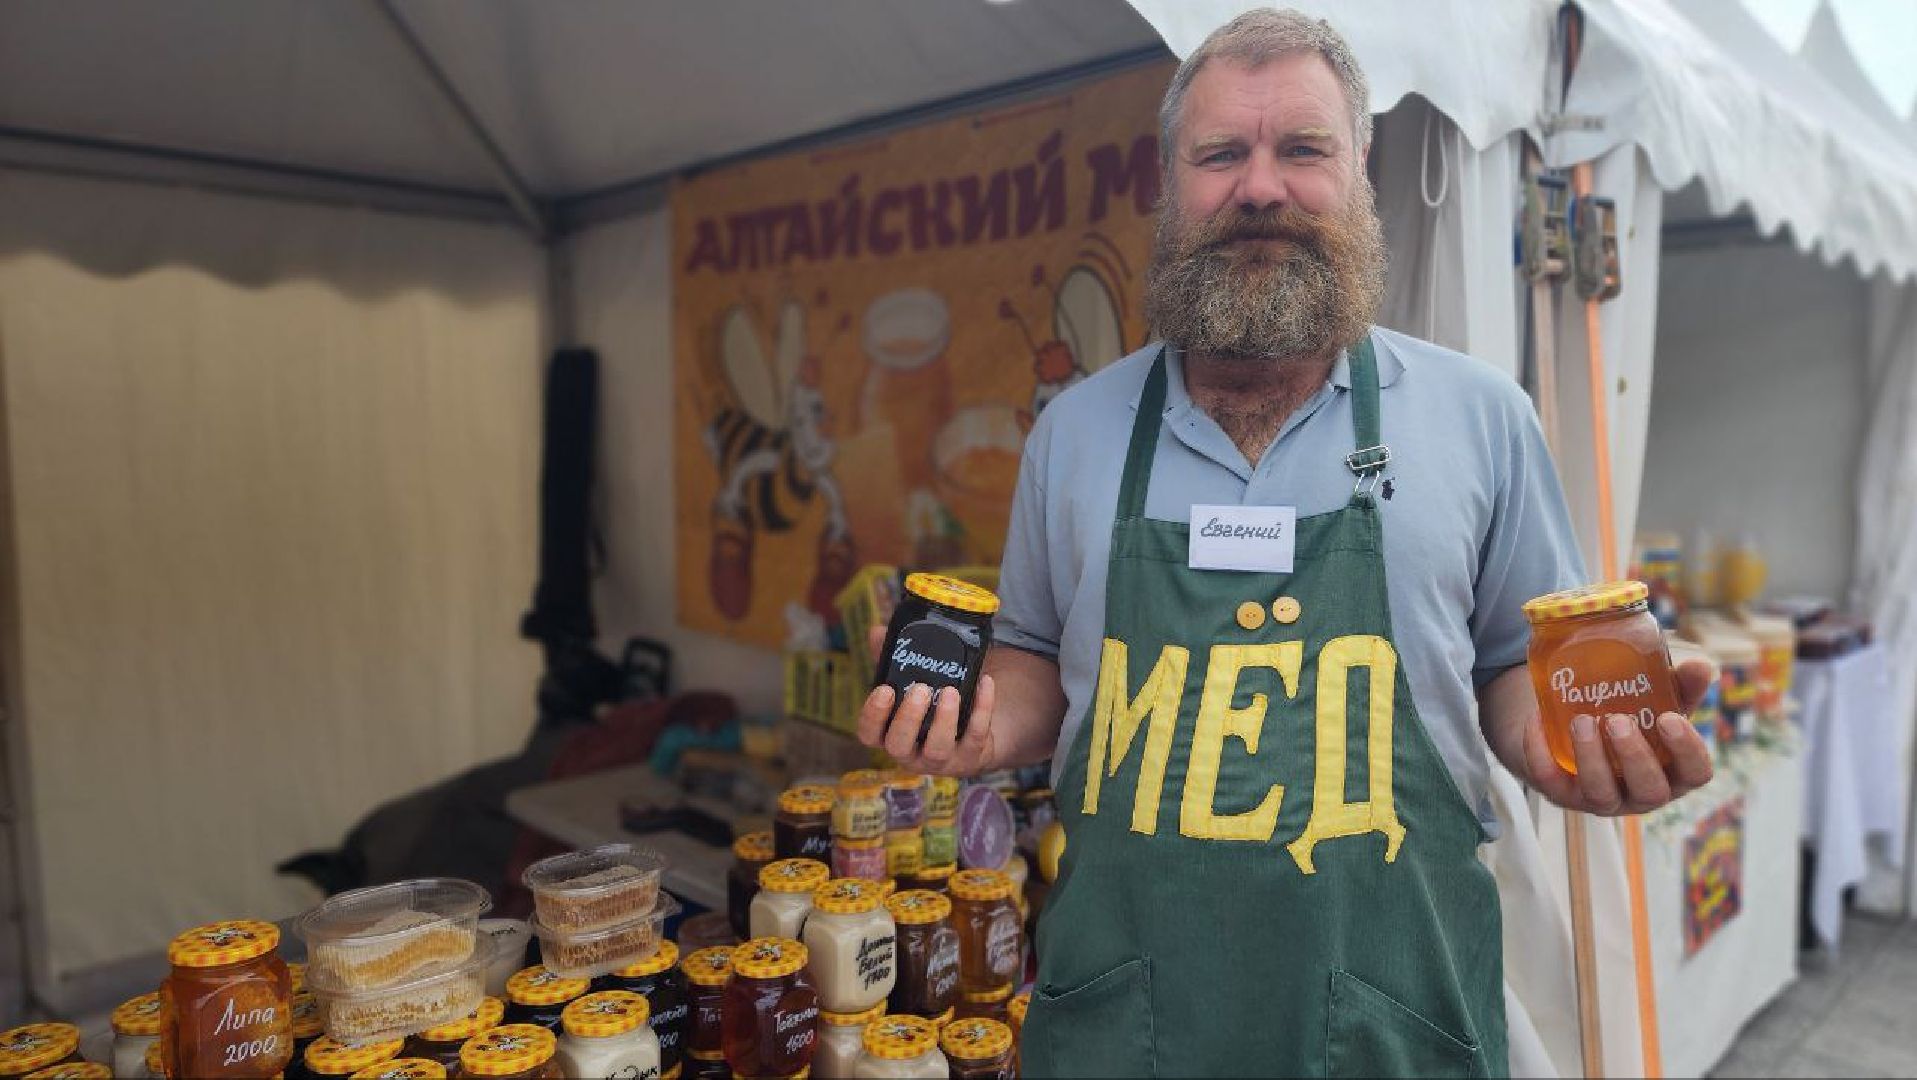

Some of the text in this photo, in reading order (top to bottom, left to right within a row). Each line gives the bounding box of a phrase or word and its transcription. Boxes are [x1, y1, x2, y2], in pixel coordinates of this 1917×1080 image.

[685, 129, 1160, 274] АЛТАЙСКИЙ М
[1200, 517, 1282, 540] Евгений
[1550, 667, 1653, 707] Фацелия
[1081, 596, 1406, 875] МЁД
[213, 998, 275, 1036] Липа
[223, 1034, 278, 1067] 2000
